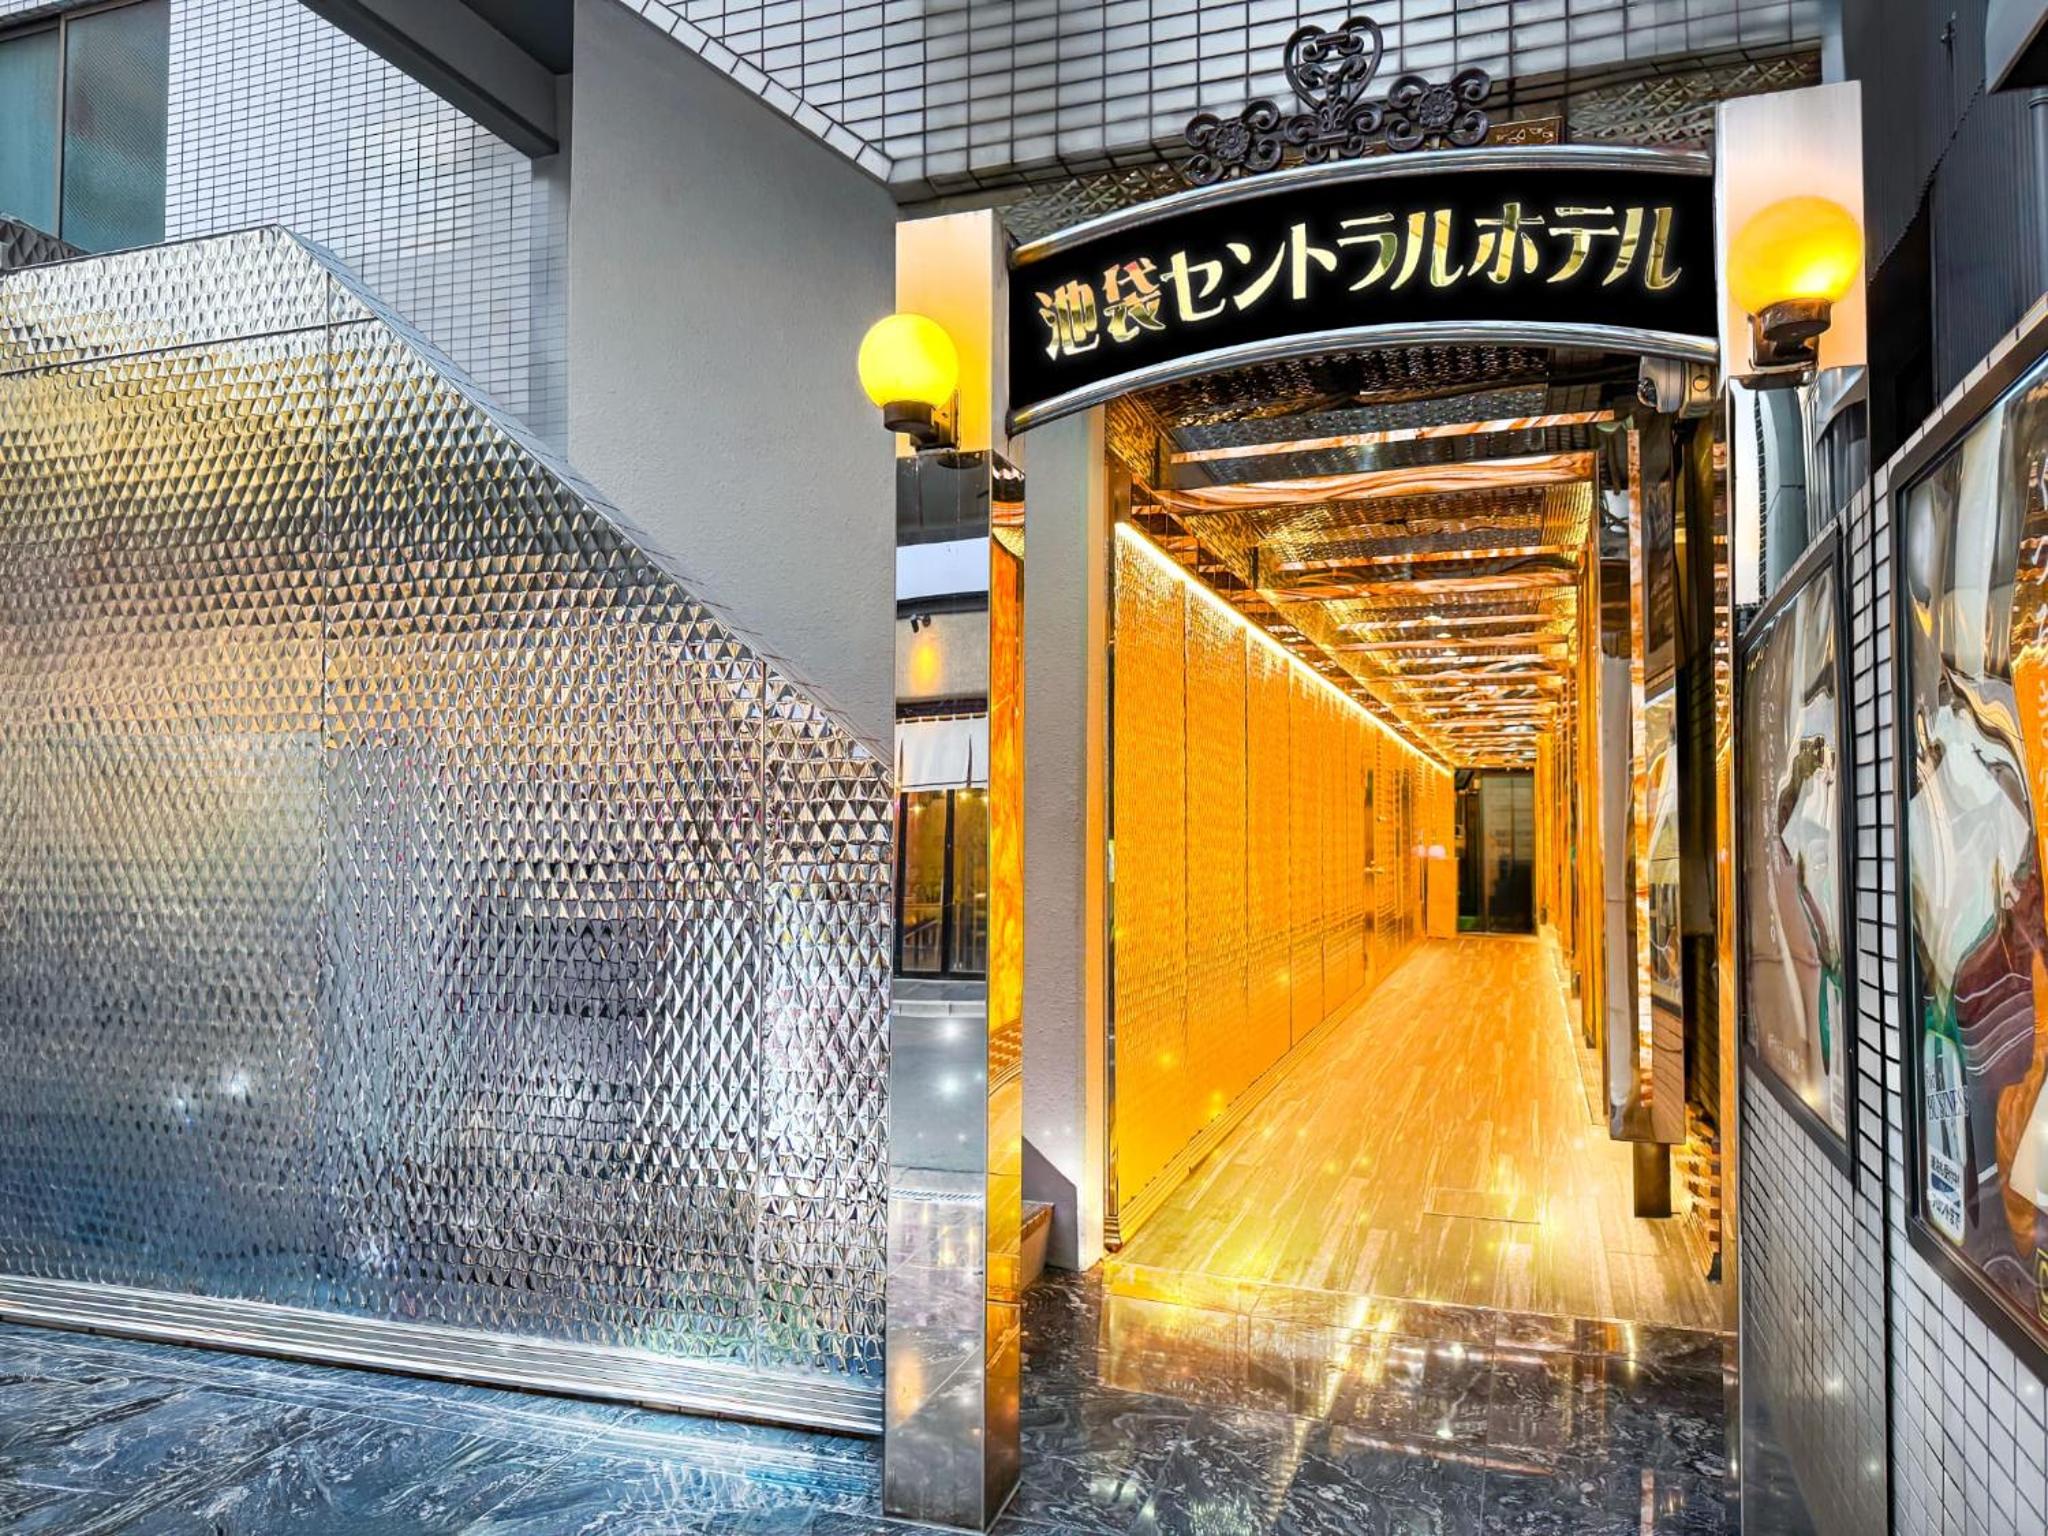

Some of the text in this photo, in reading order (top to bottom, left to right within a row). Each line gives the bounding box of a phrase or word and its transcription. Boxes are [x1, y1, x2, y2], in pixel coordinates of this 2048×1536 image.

[1036, 202, 1683, 361] 池袋セントラルホテル
